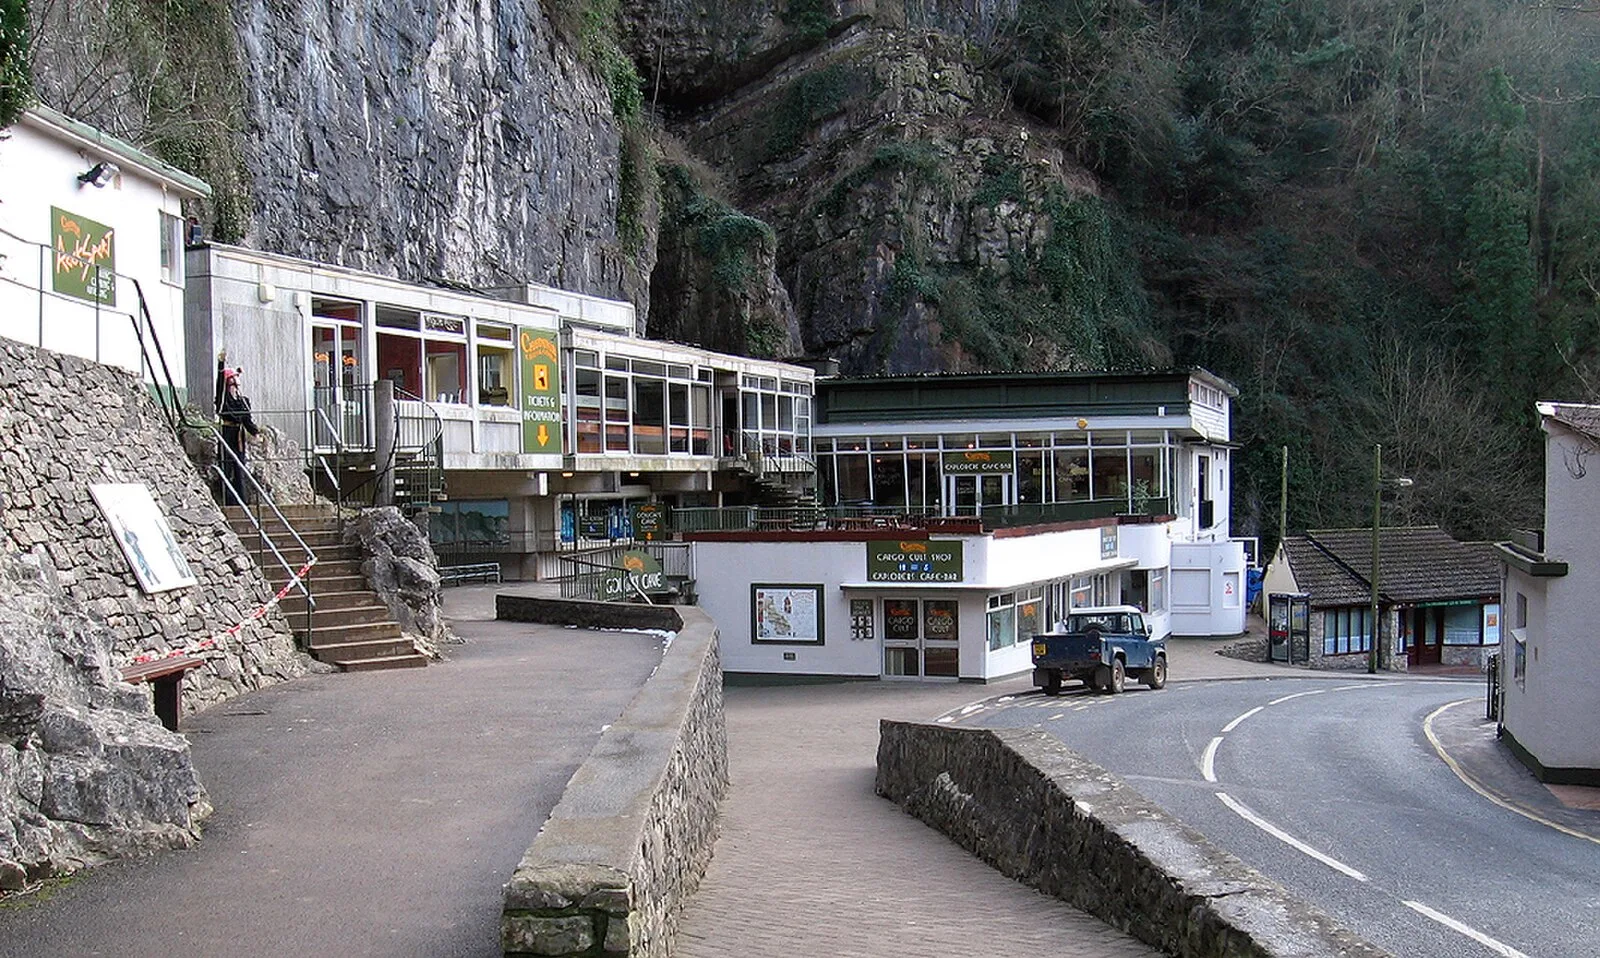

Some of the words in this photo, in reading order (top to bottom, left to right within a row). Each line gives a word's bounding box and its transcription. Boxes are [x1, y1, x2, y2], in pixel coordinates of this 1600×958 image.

[876, 552, 905, 562] CARGO
[908, 552, 927, 562] CULT
[931, 552, 953, 562] SHOP
[641, 572, 662, 589] CAVE
